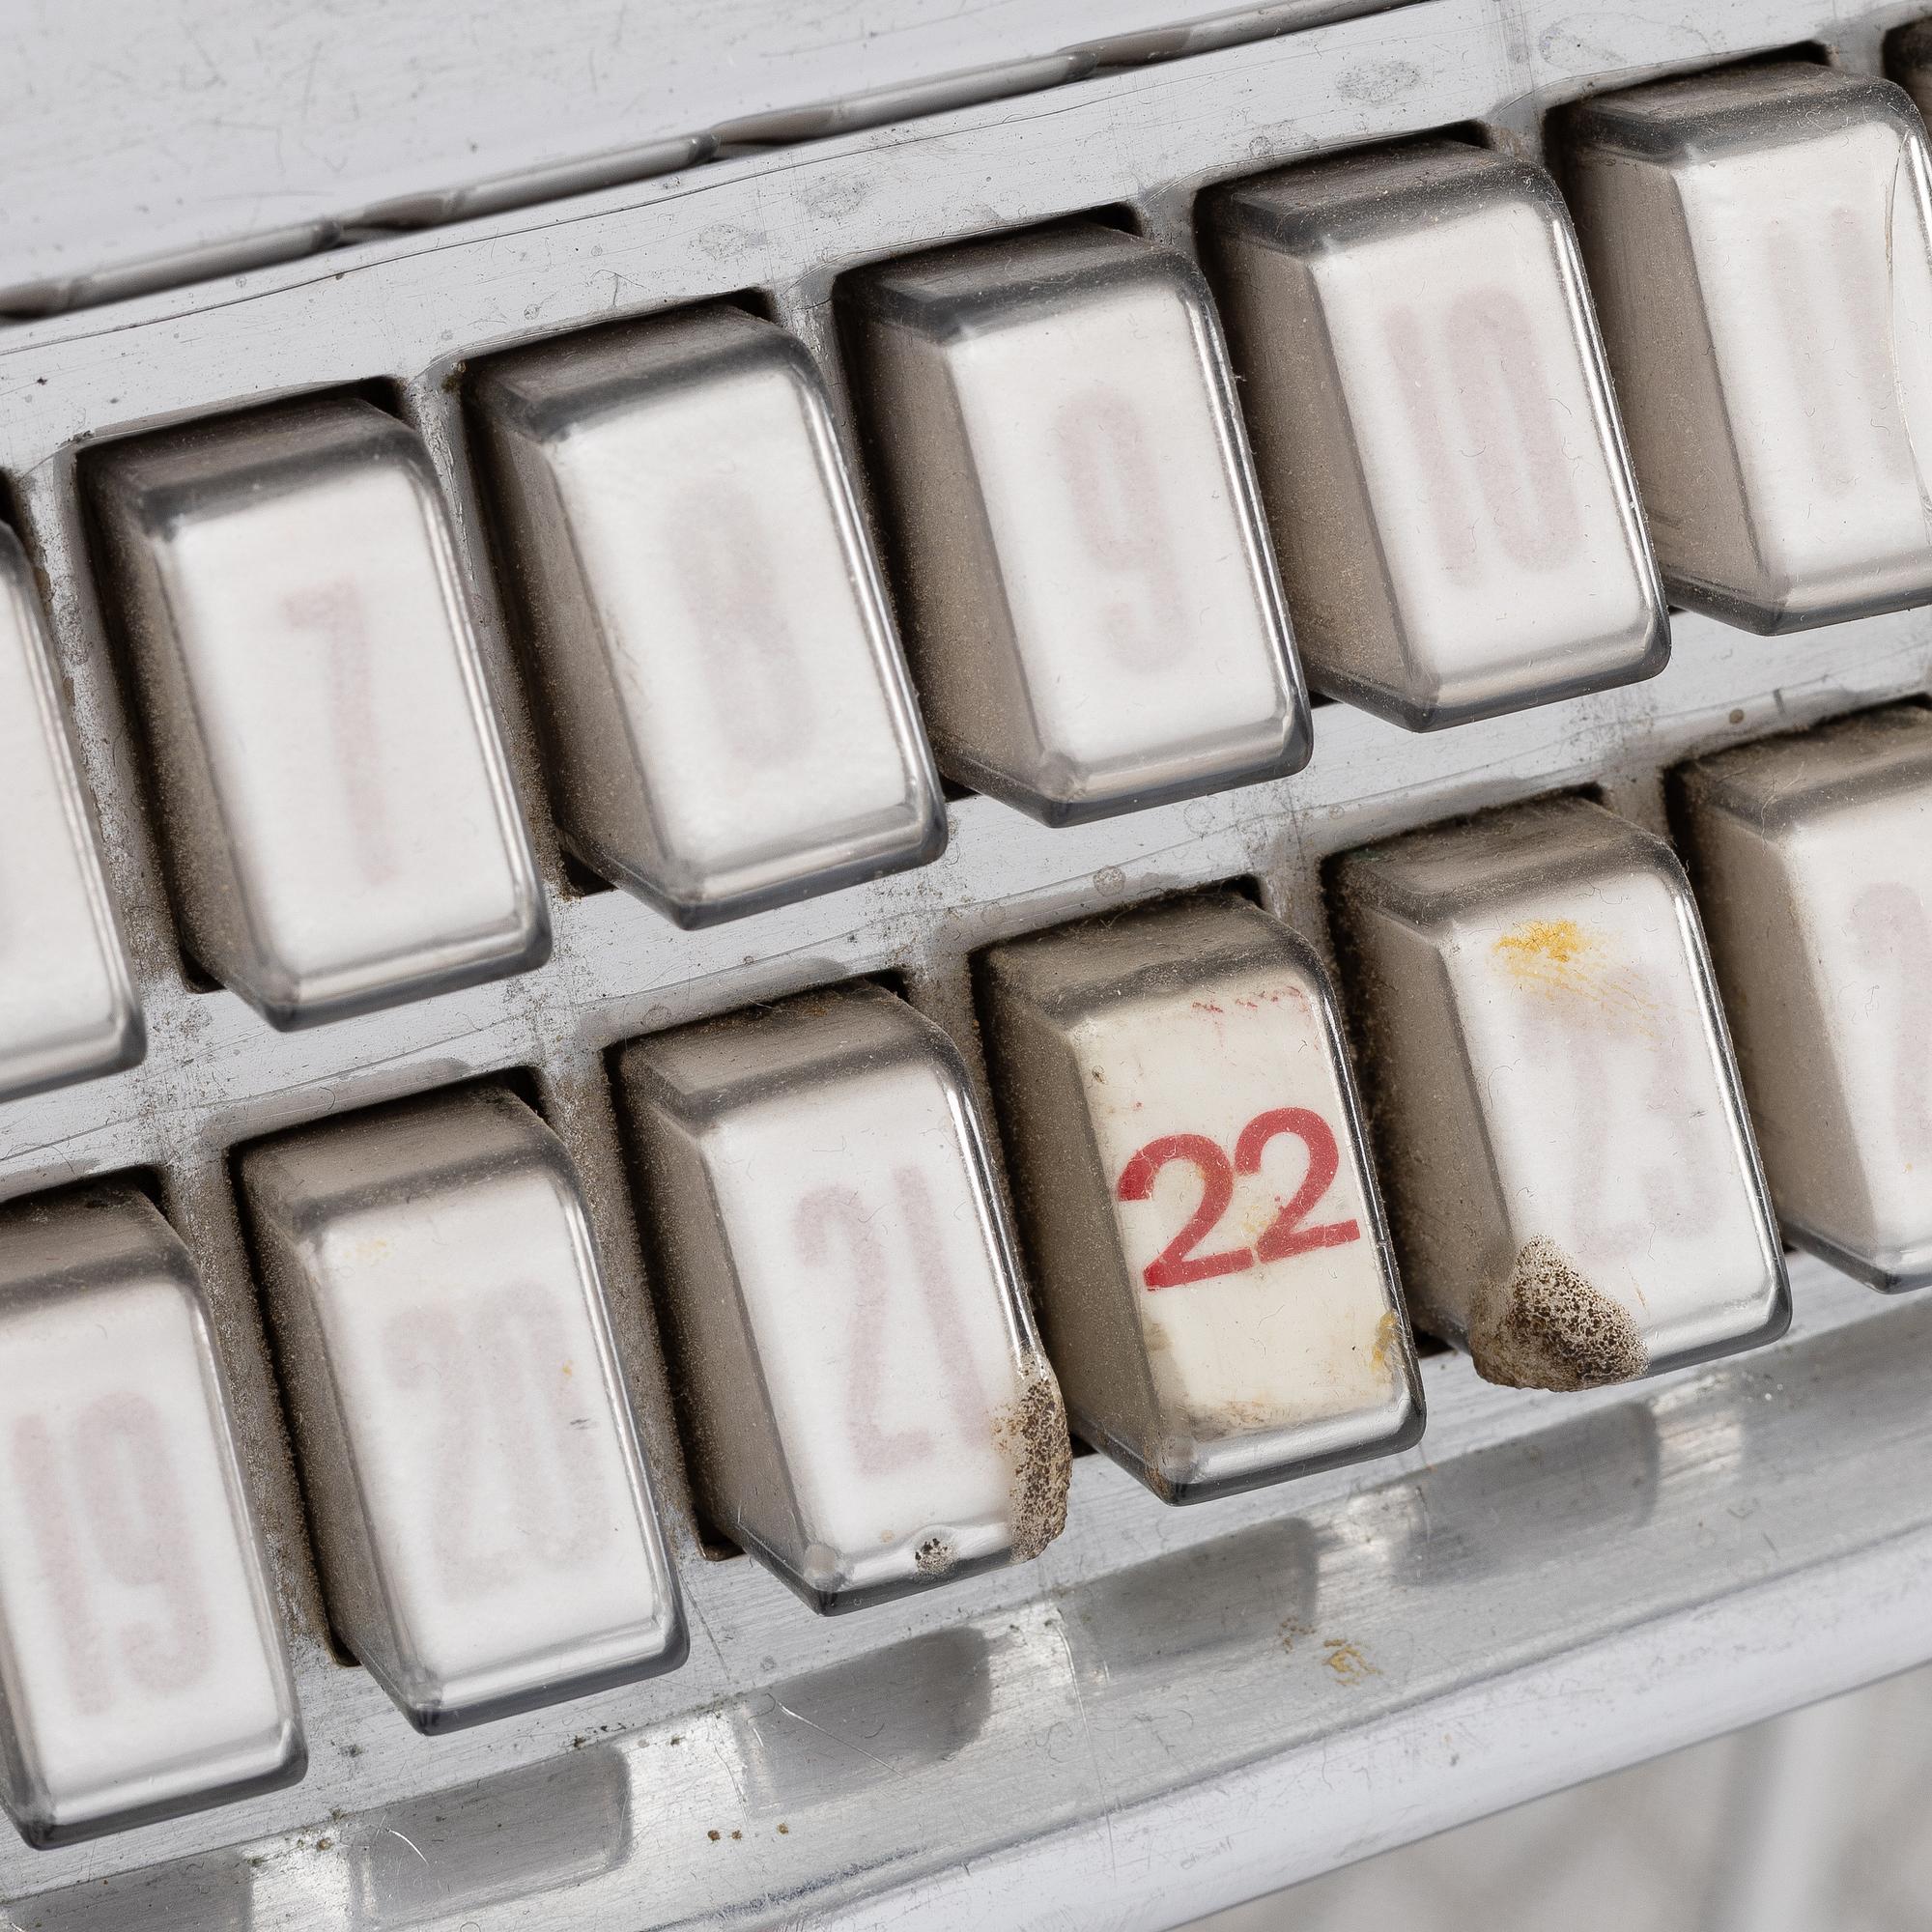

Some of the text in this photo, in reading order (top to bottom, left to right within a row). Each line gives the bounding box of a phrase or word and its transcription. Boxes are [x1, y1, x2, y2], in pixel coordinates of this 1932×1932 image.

[1053, 391, 1200, 672] 9
[1378, 282, 1582, 587] 10
[1117, 1106, 1361, 1292] 22
[1519, 962, 1722, 1263] 23
[380, 1278, 616, 1599] 20
[792, 1163, 1001, 1476] 21
[10, 1387, 214, 1718] 19
